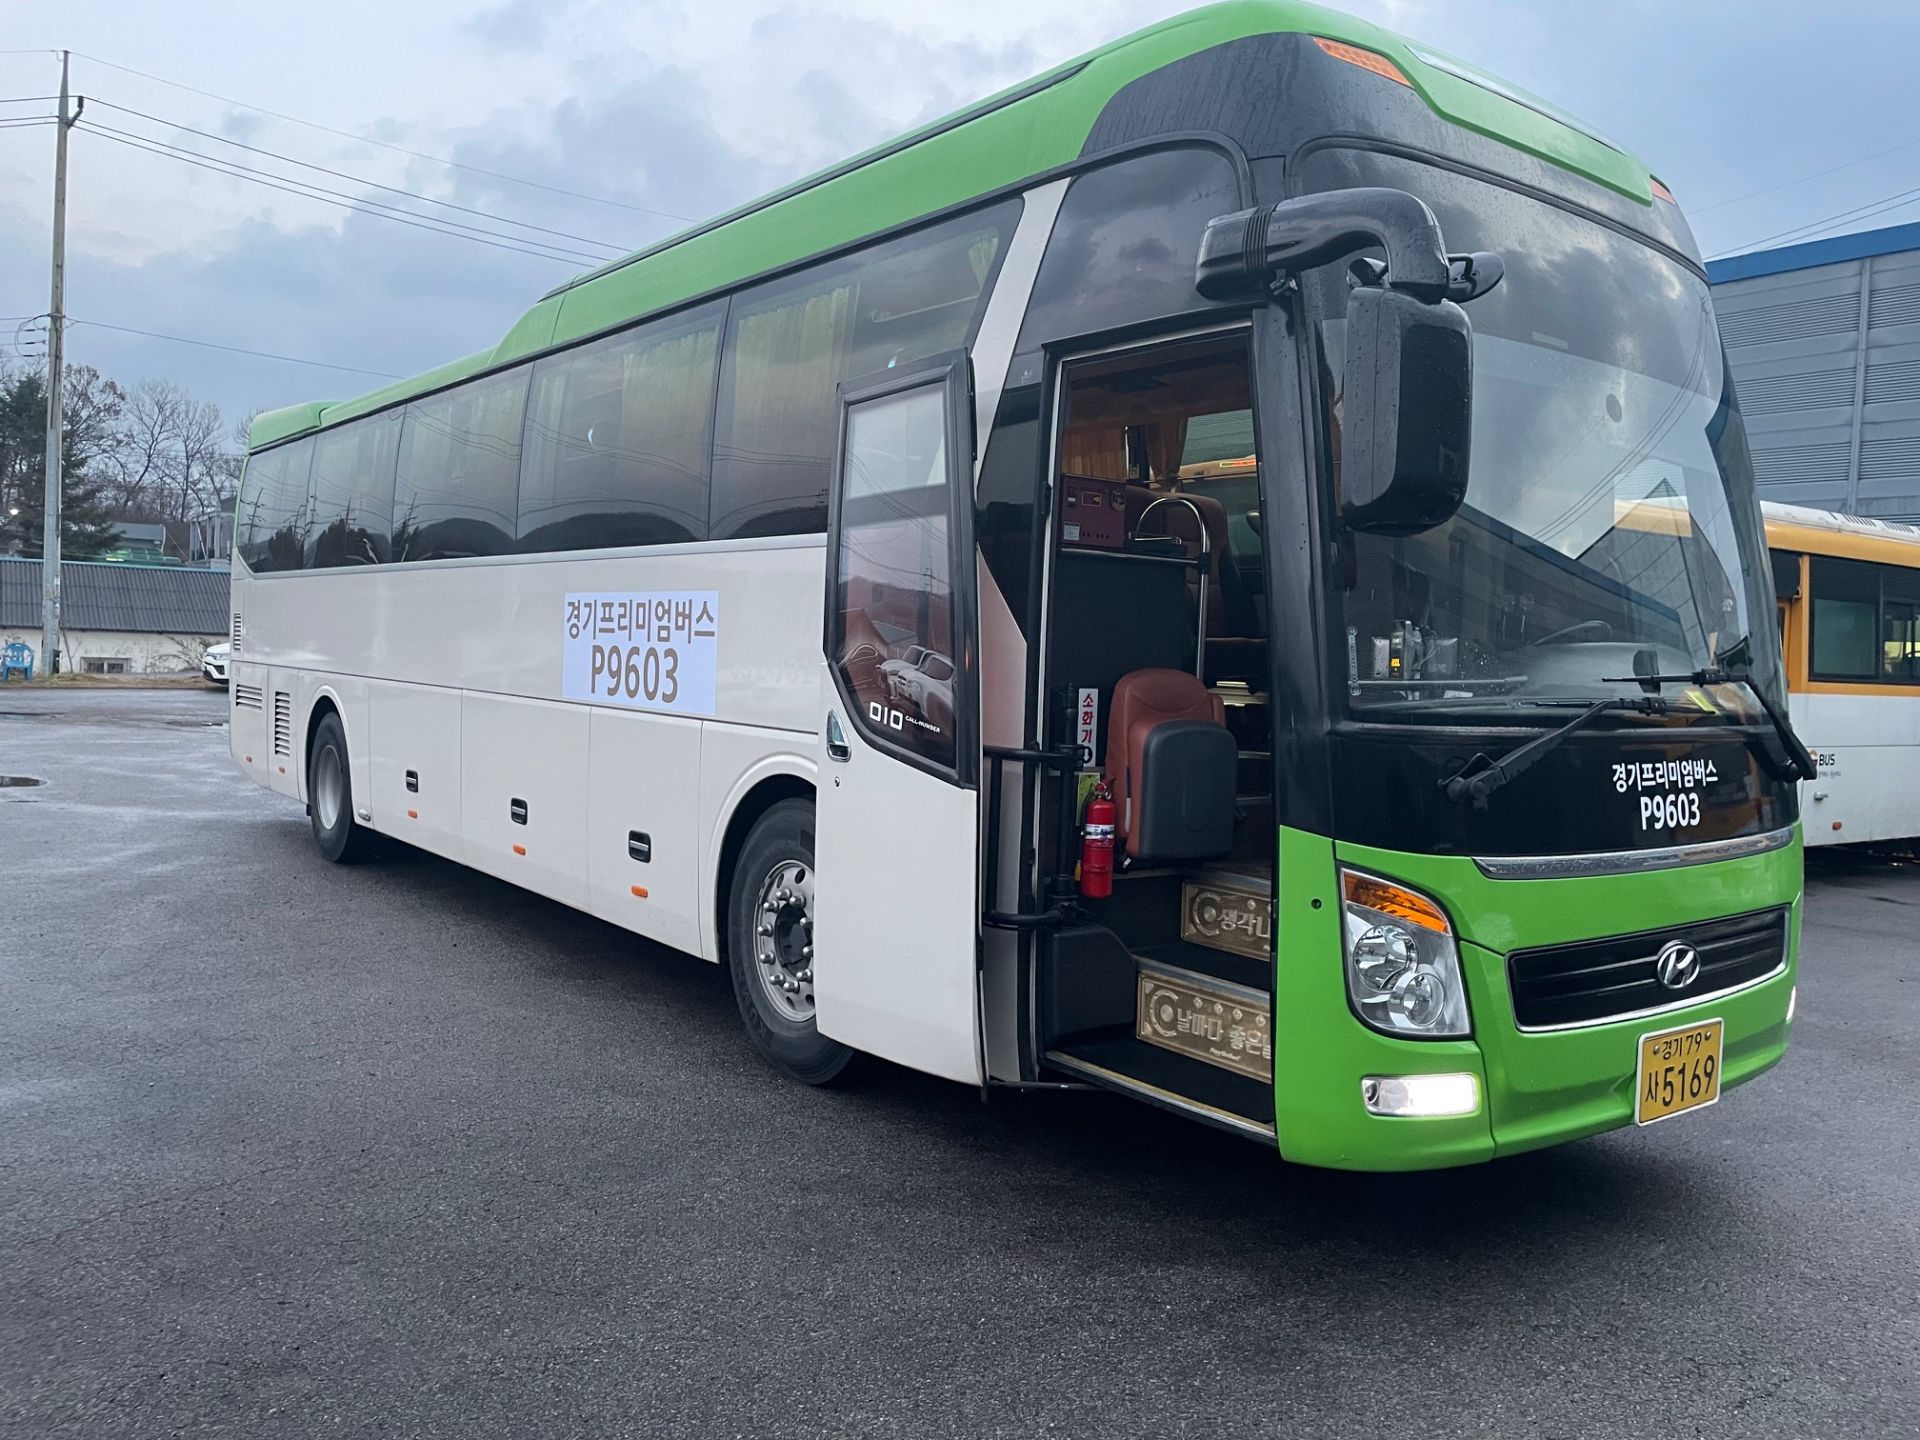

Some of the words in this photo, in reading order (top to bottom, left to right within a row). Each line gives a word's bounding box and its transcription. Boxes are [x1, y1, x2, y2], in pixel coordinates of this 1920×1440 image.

[567, 599, 715, 644] 경기프리미엄버스
[591, 645, 679, 703] P9603
[1081, 693, 1093, 743] 소화기
[1612, 758, 1719, 793] 경기프리미엄버스
[1818, 753, 1836, 767] BUS
[1640, 792, 1701, 830] P9603
